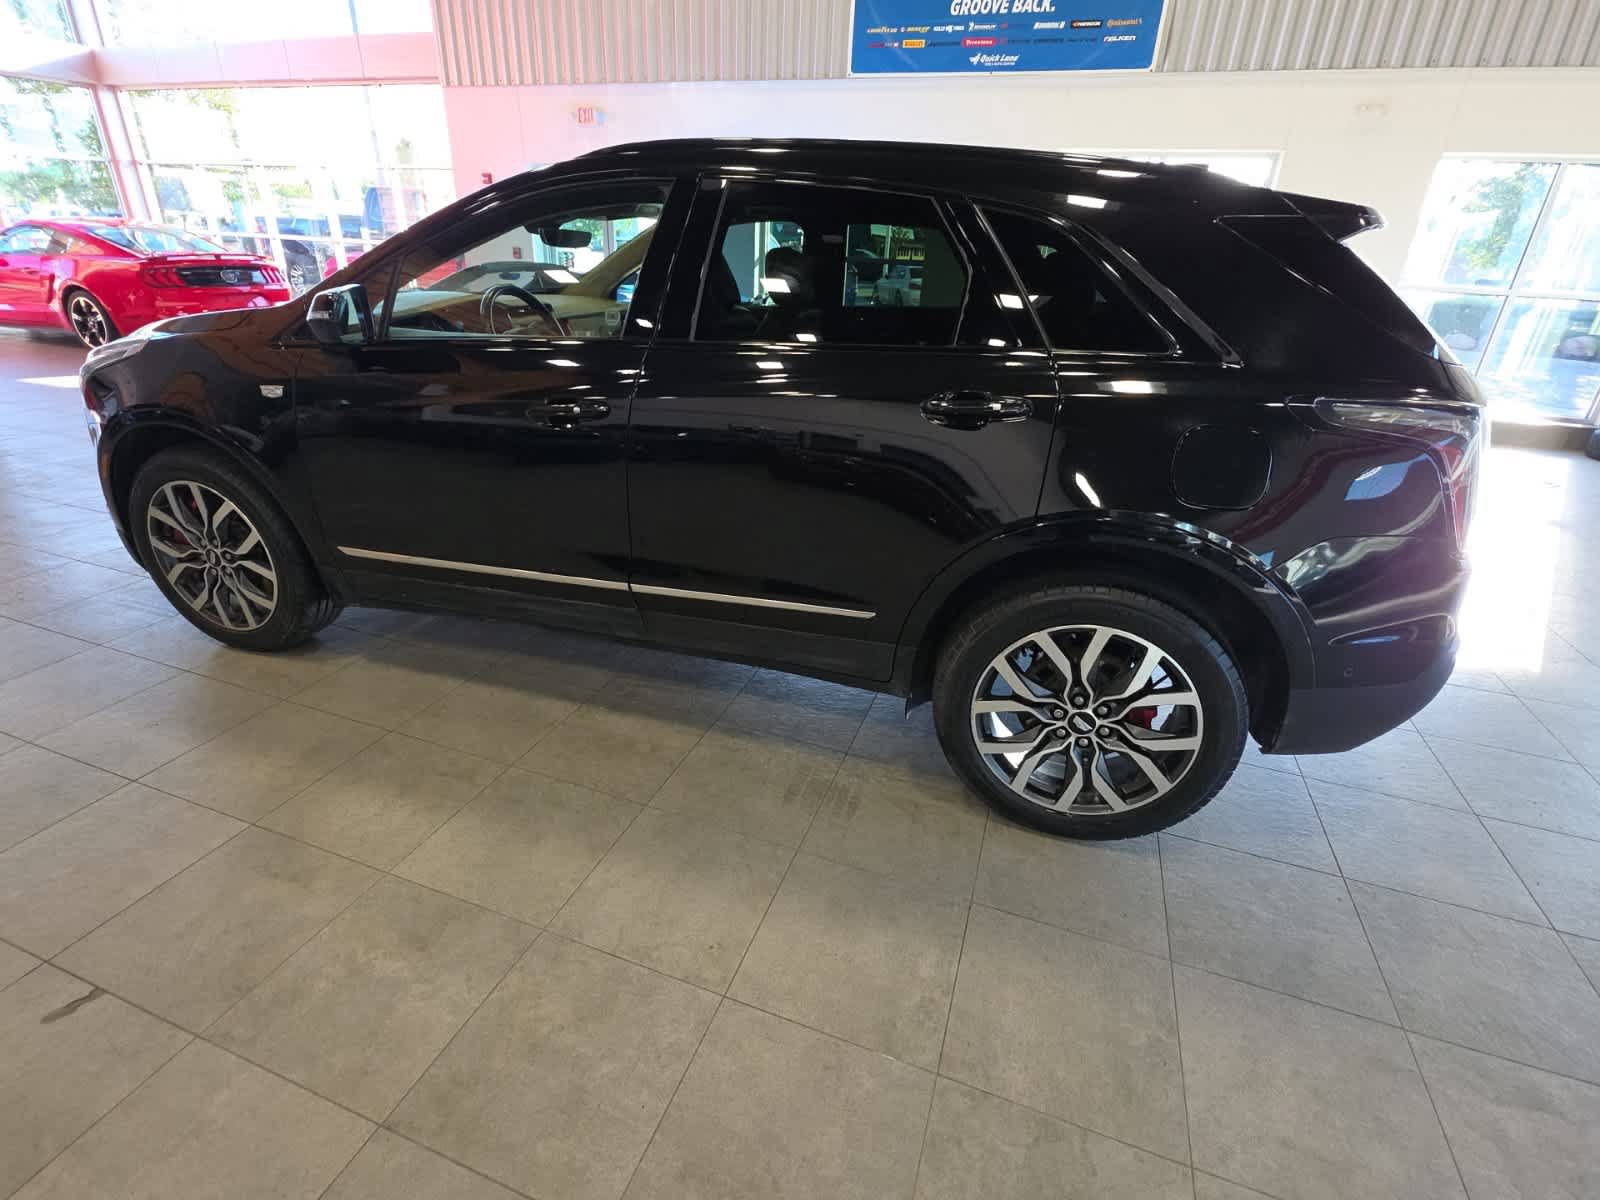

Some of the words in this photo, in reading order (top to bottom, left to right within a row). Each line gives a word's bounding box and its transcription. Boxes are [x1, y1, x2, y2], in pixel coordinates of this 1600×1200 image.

[950, 0, 1009, 15] GROOVE
[1012, 0, 1056, 13] BACK.
[980, 53, 1000, 63] Quick
[1000, 53, 1020, 62] Lane
[578, 107, 594, 123] EXIT
